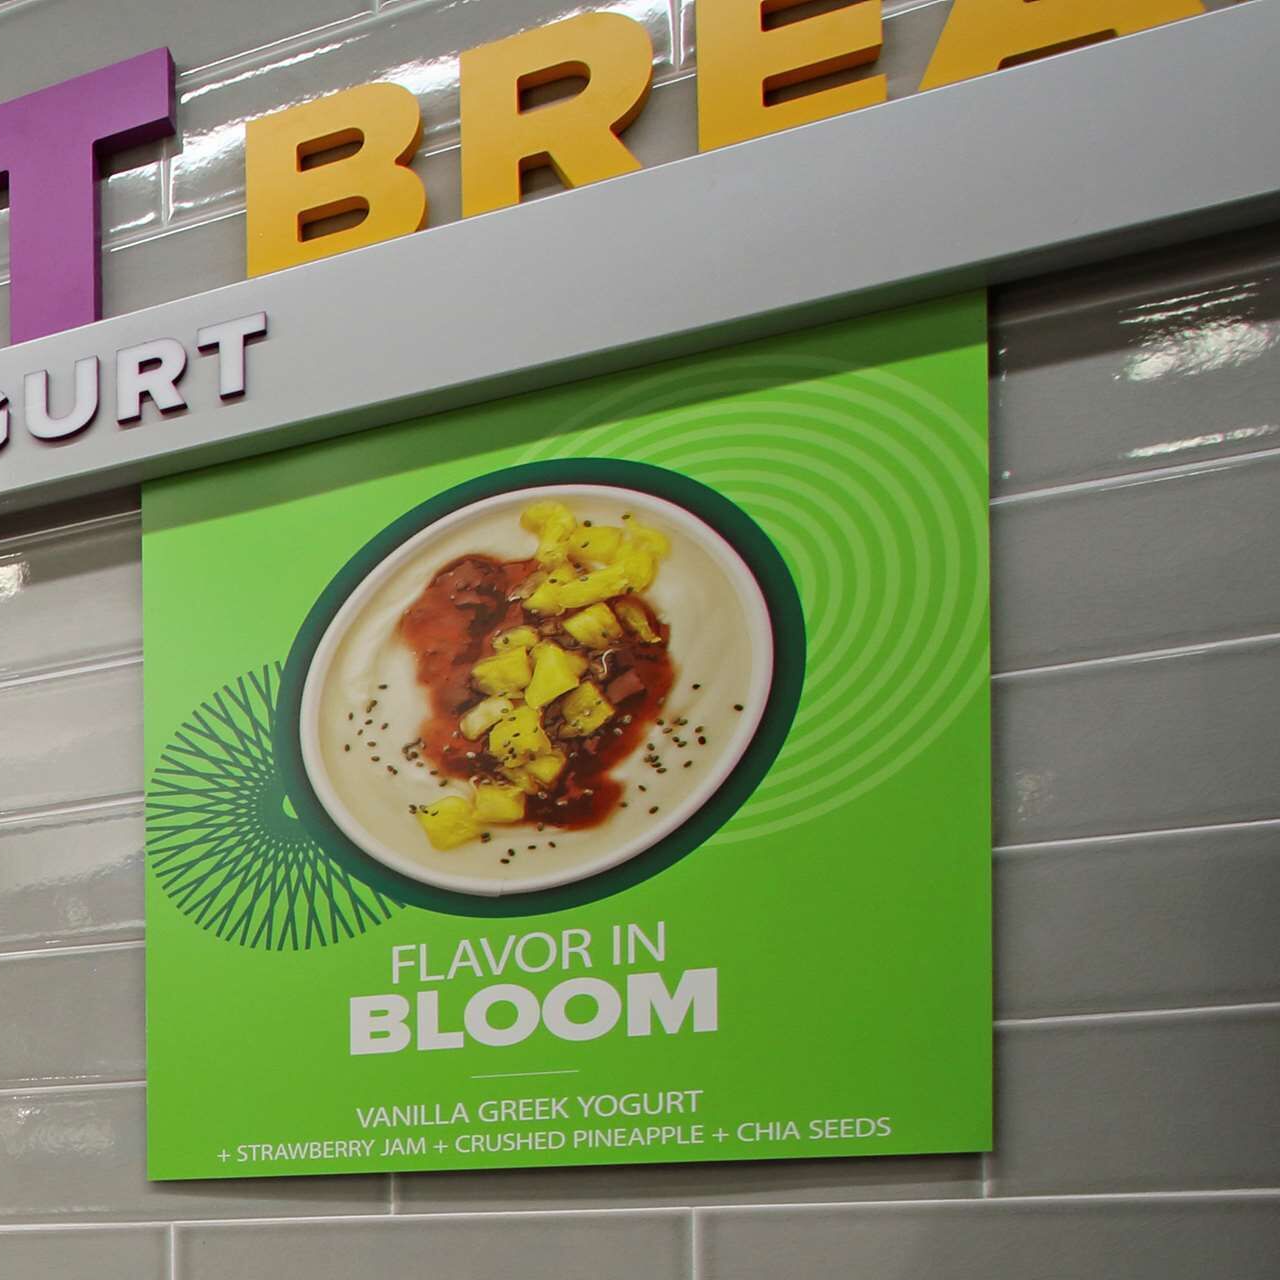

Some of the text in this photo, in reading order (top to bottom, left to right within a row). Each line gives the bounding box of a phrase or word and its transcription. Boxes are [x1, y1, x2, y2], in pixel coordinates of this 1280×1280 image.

[391, 920, 667, 985] FLAVOR IN
[349, 967, 719, 1056] BLOOM
[356, 1089, 704, 1130] VANILLA GREEK YOGURT
[217, 1115, 891, 1164] + STRAWBERRY JAM + CRUSHED PINEAPPLE + CHIA SEEDS
